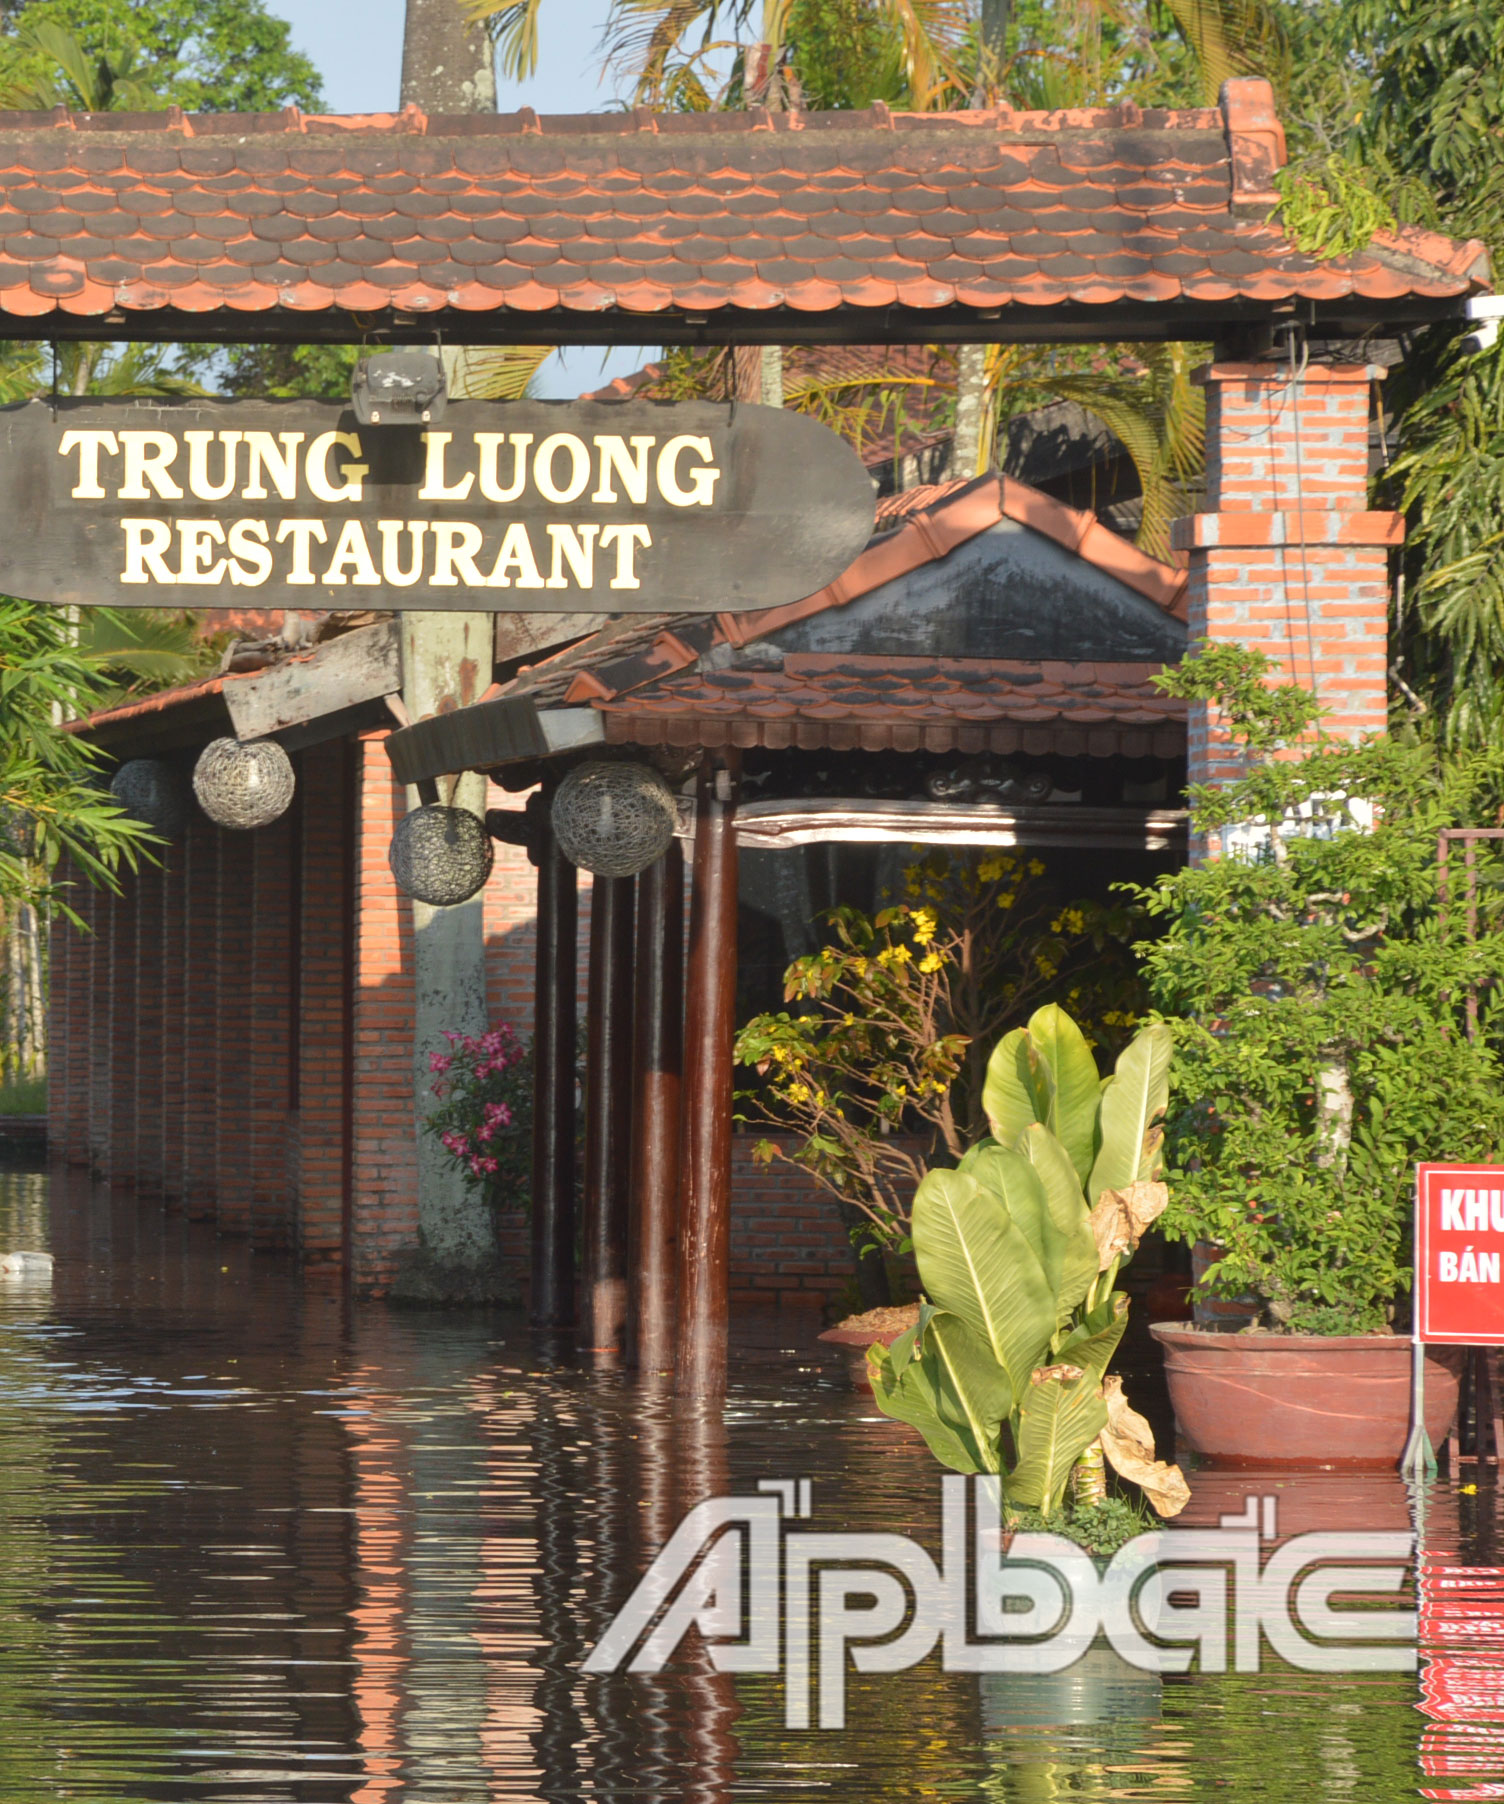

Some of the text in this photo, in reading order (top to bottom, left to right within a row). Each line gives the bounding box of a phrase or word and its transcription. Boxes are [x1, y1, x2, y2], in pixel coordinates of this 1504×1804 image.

[58, 430, 721, 506] TRUNG LUONG
[120, 518, 652, 589] RESTAURANT
[1439, 1245, 1501, 1283] BÁN
